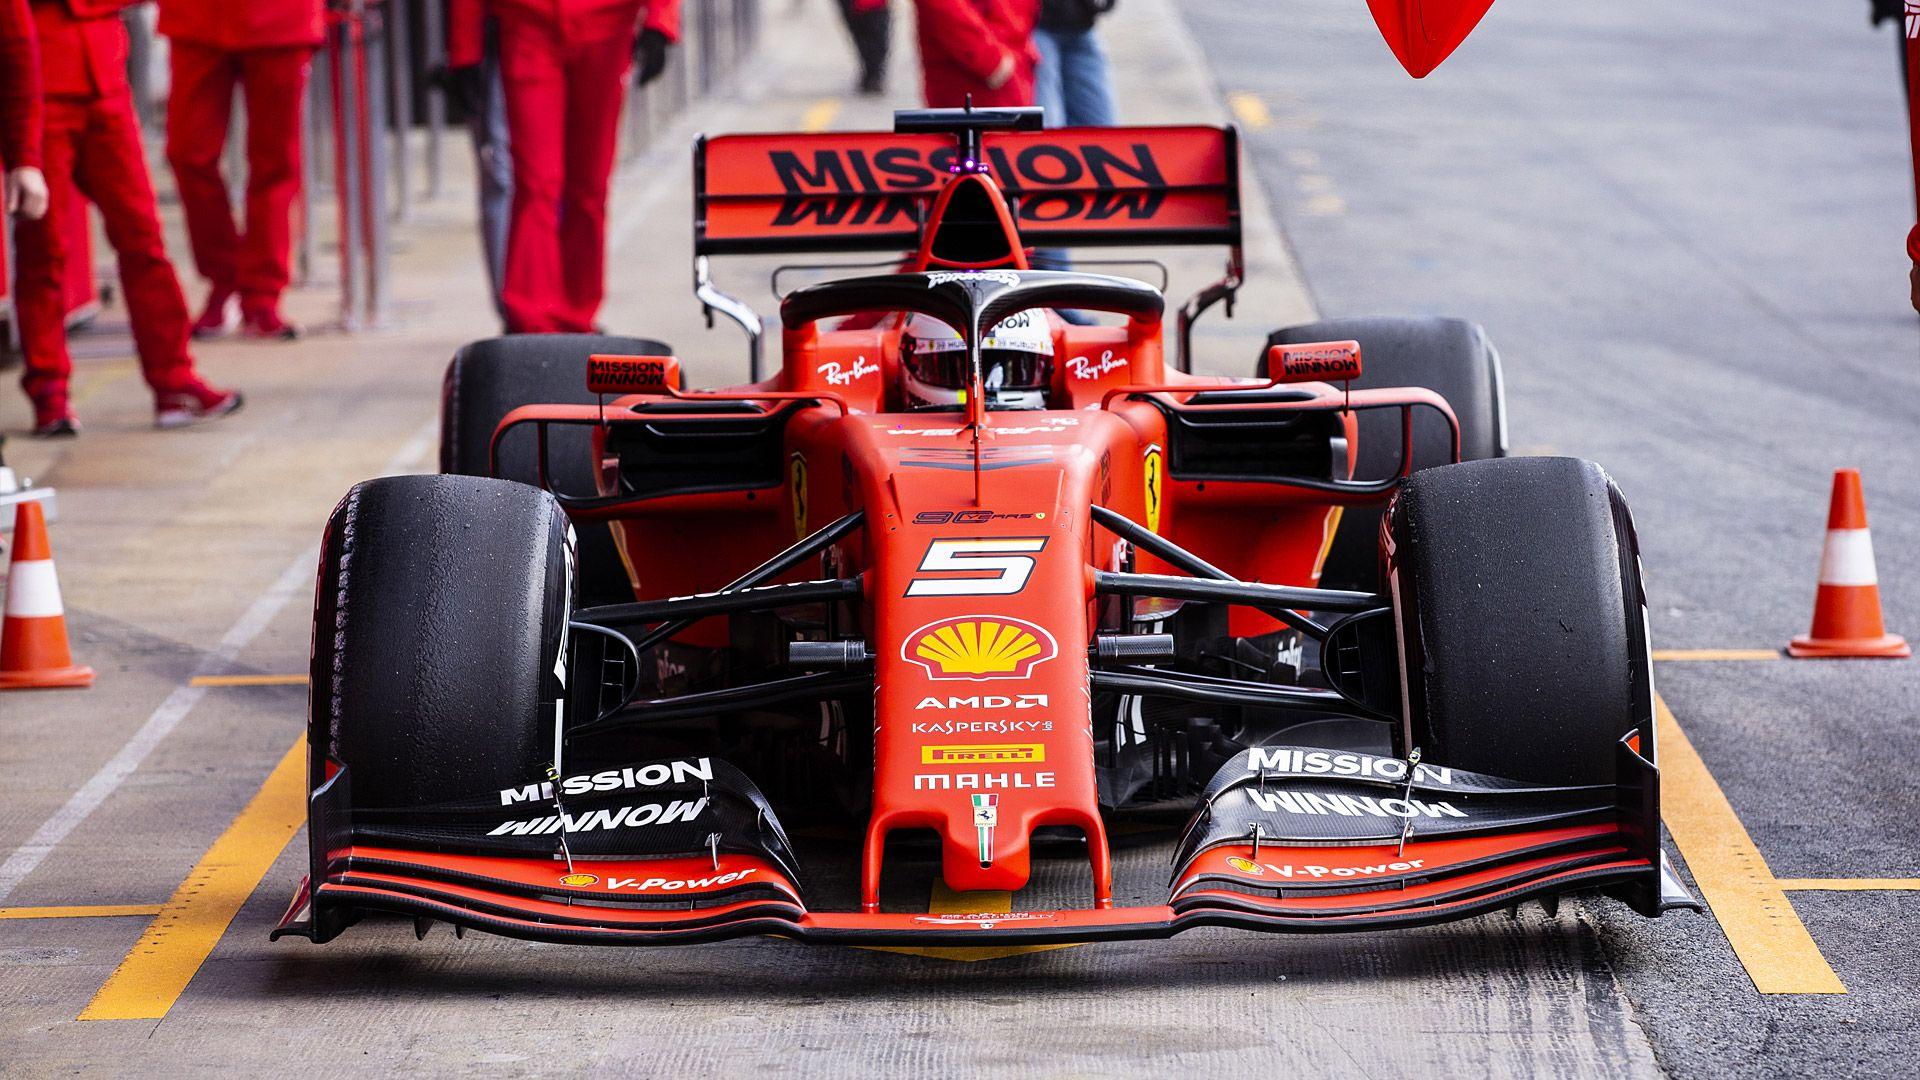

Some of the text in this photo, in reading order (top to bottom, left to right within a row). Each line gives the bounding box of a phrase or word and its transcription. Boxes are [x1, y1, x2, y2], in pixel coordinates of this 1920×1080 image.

[770, 193, 1167, 225] WINOW
[1284, 348, 1357, 363] MISSION
[590, 361, 665, 374] MISSION
[1284, 359, 1358, 376] WINNOW
[589, 373, 665, 386] WINNOW
[903, 536, 1050, 598] 5
[914, 695, 1012, 710] AMD
[911, 720, 1040, 735] KASPERSKY
[932, 747, 1034, 760] PIRELLI
[1247, 747, 1452, 785] MISSION
[500, 757, 714, 806] MISSION
[914, 772, 1056, 790] MAHLE
[1246, 787, 1469, 818] WINNOW
[486, 797, 710, 836] WINNOW
[1264, 858, 1425, 878] V-Power
[606, 867, 757, 891] V-Power
